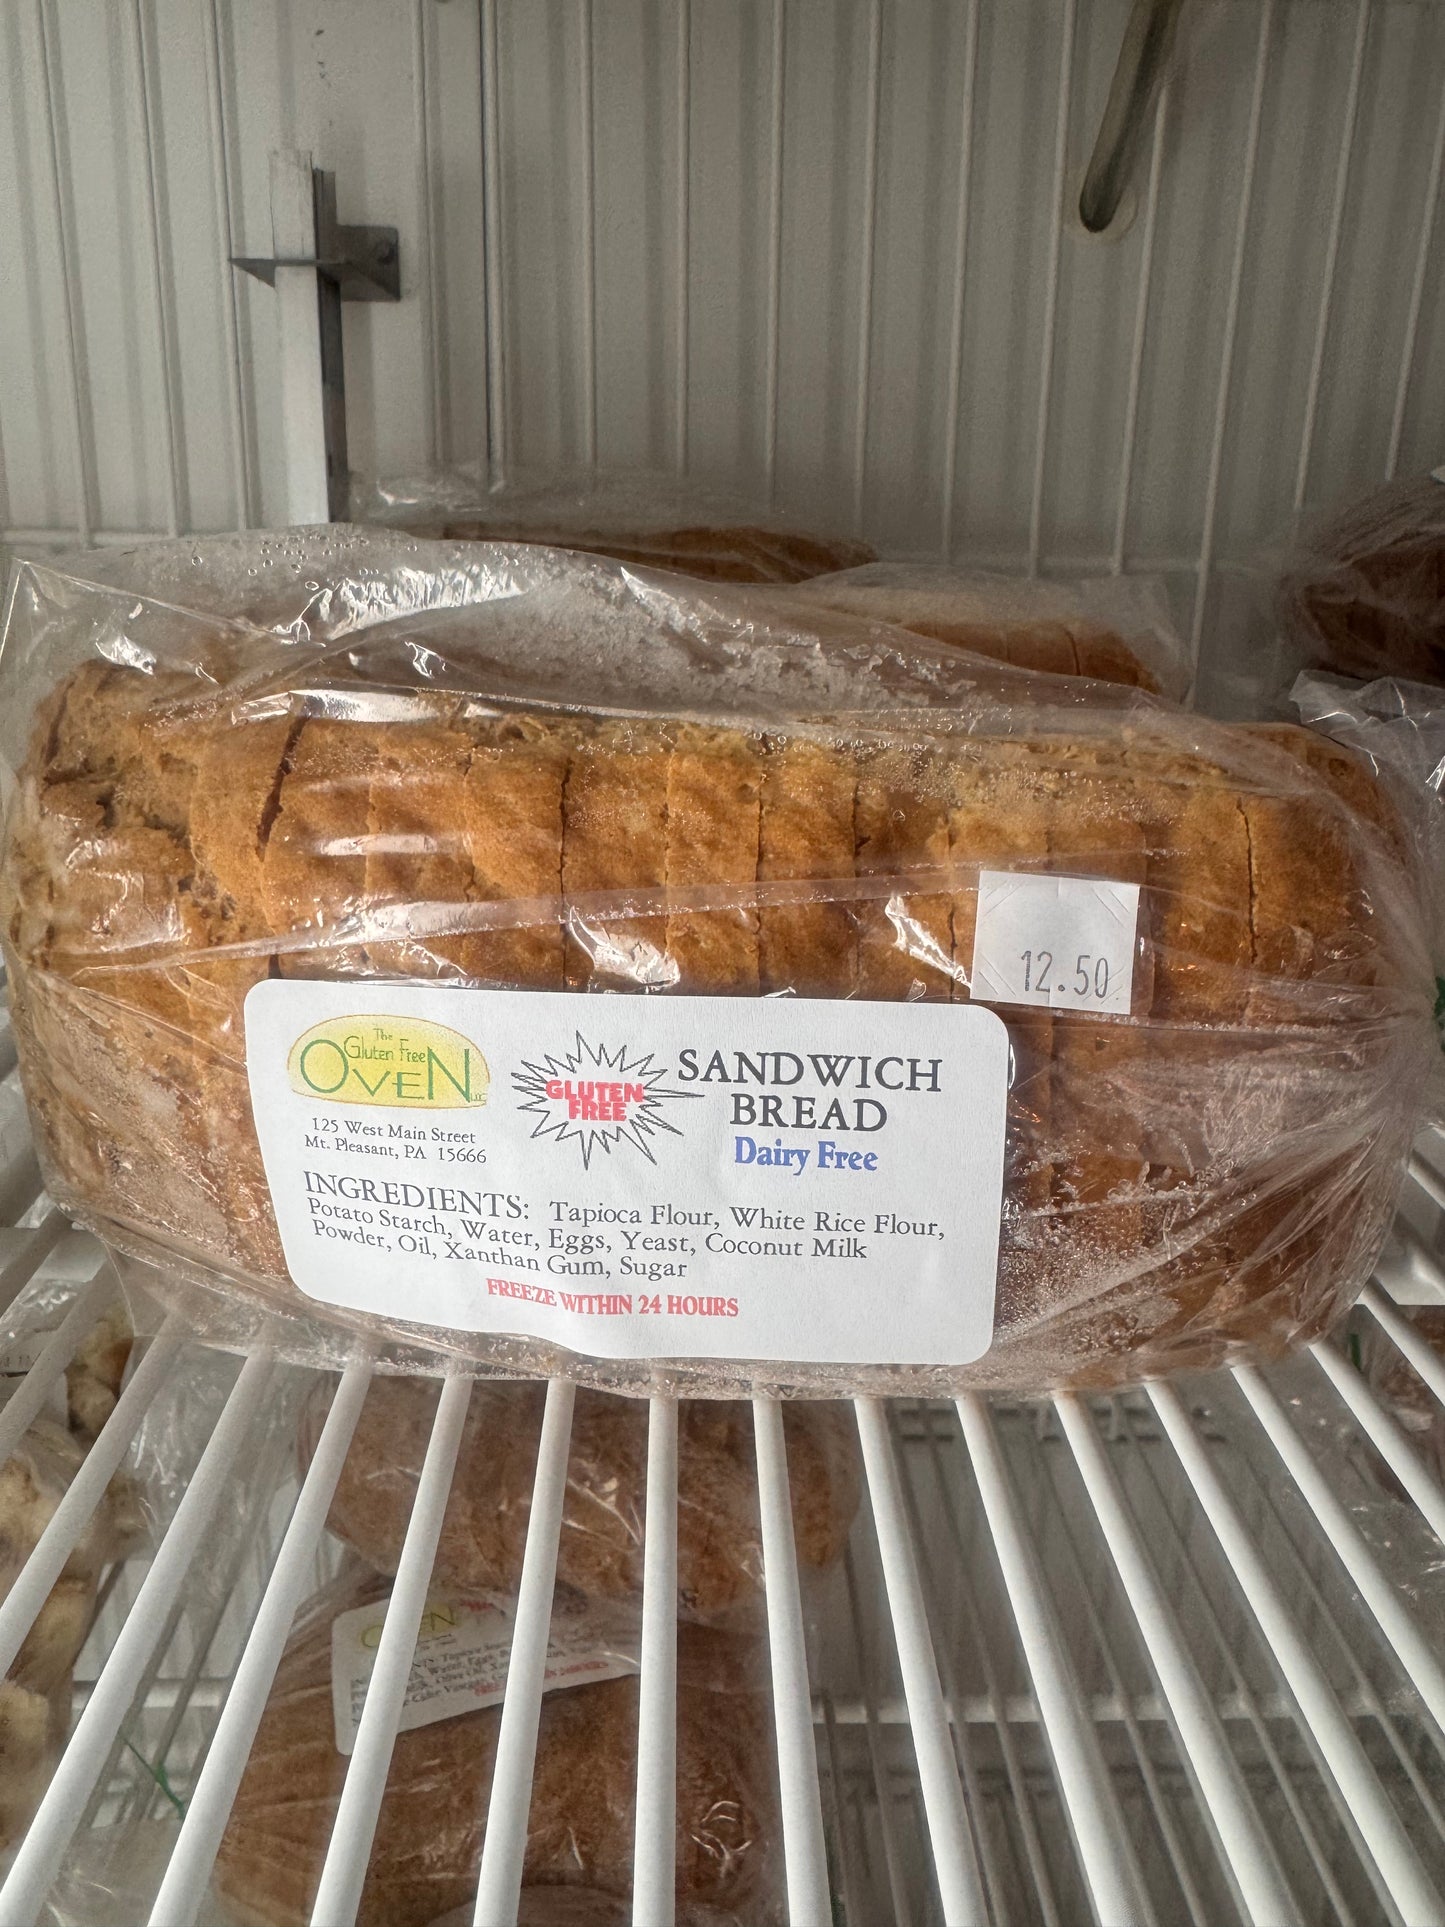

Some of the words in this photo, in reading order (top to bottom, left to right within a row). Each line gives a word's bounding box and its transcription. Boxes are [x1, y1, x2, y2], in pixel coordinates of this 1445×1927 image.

[1021, 950, 1109, 998] 12.50
[343, 1035, 394, 1060] Gluten
[400, 1038, 426, 1063] Free
[373, 1027, 393, 1041] The
[678, 1048, 943, 1092] SANDWICH
[545, 1079, 645, 1103] GLUTEN
[312, 1117, 339, 1133] 125
[344, 1120, 384, 1137] West
[387, 1124, 427, 1141] Main
[431, 1127, 476, 1144] Street
[568, 1100, 628, 1122] FREE
[729, 1093, 888, 1132] BREAD
[304, 1134, 331, 1150] Mt.
[335, 1137, 400, 1160] Pleasant,
[404, 1144, 427, 1160] PA
[438, 1147, 487, 1164] 15666
[734, 1136, 811, 1176] Dairy
[818, 1140, 879, 1171] Free
[303, 1170, 529, 1220] INGREDIENTS:
[550, 1200, 643, 1228] Tapioca
[650, 1203, 720, 1229] Flour,
[729, 1206, 806, 1231] White
[813, 1210, 866, 1233] Rice
[873, 1213, 945, 1241] Flour,
[307, 1196, 374, 1224] Potato
[379, 1209, 453, 1239] Starch,
[459, 1218, 540, 1251] Water,
[548, 1228, 612, 1255] Eggs,
[621, 1230, 696, 1256] Yeast,
[705, 1232, 803, 1256] Coconut
[811, 1237, 867, 1258] Milk
[312, 1218, 392, 1252] Powder,
[398, 1234, 437, 1260] Oil,
[443, 1240, 540, 1272] Xanthan
[547, 1254, 611, 1279] Gum,
[620, 1256, 688, 1281] Sugar
[486, 1278, 557, 1307] FREEZE
[558, 1291, 633, 1315] WITHIN
[638, 1294, 662, 1315] 24
[667, 1295, 739, 1318] HOURS
